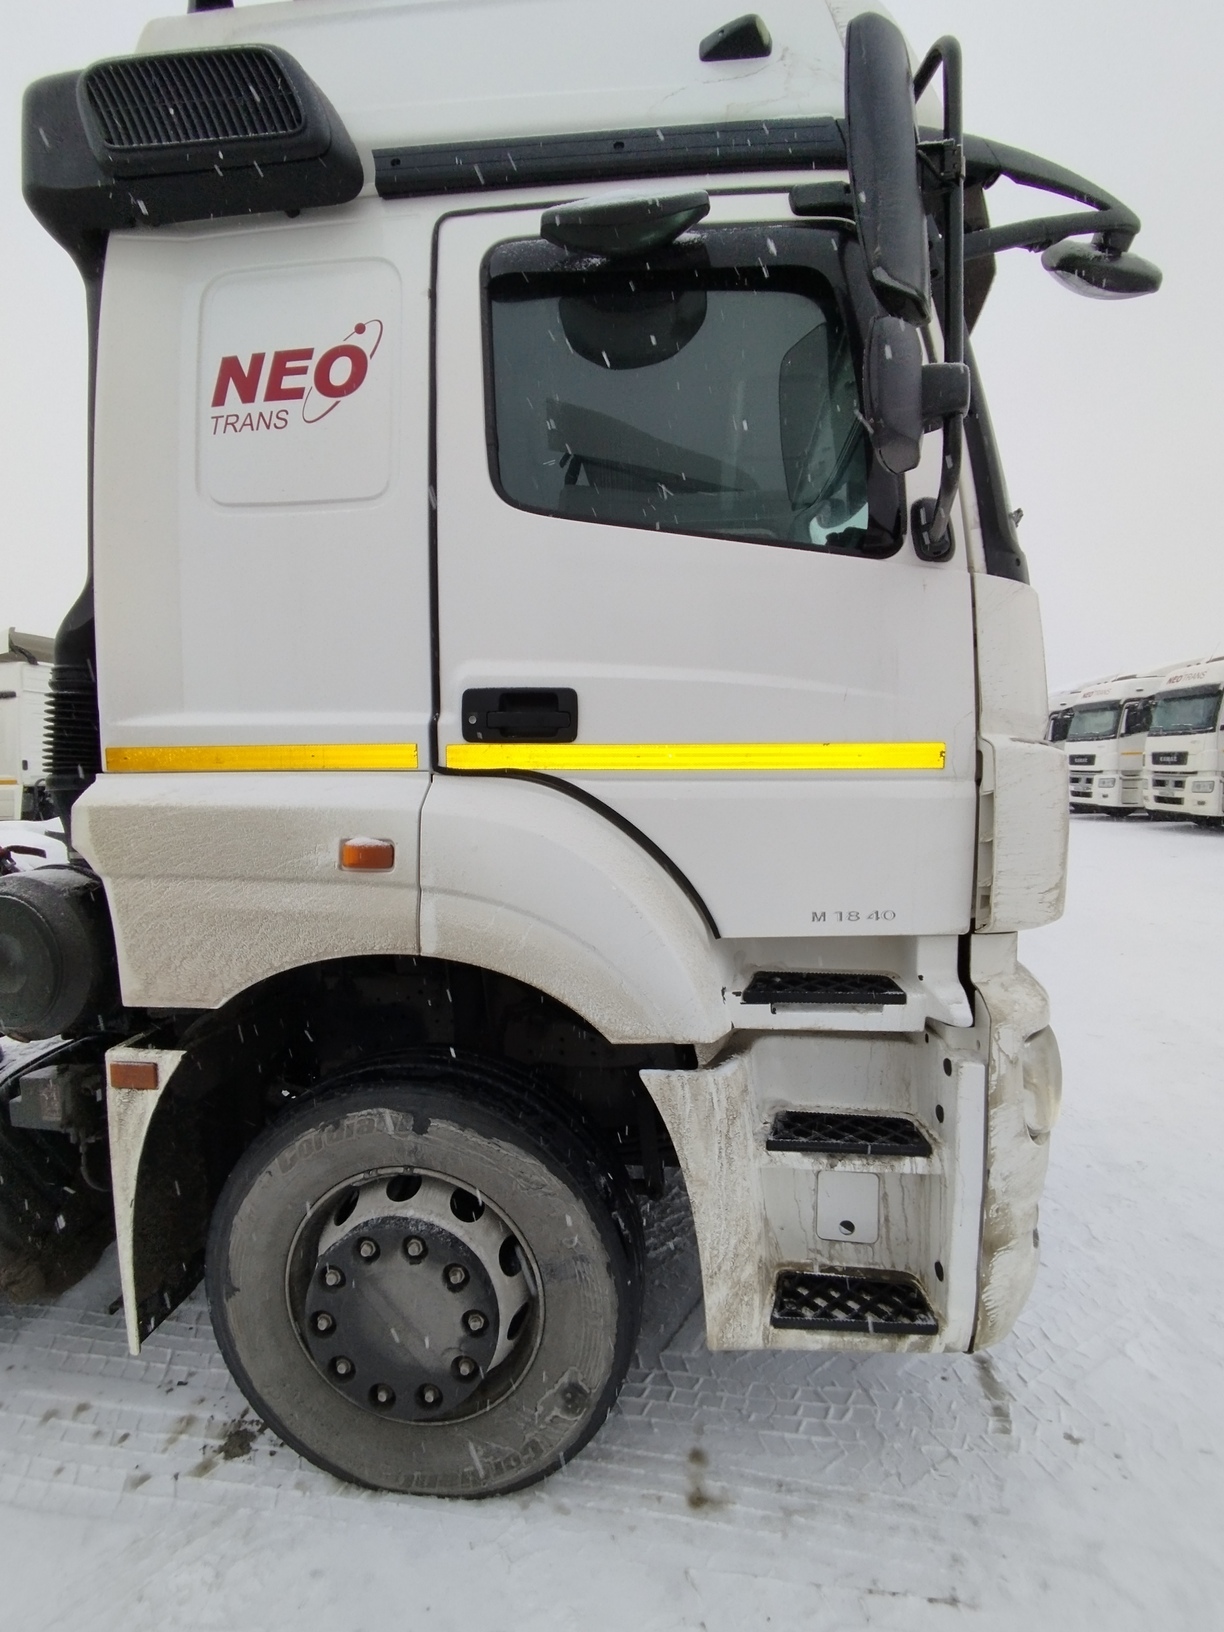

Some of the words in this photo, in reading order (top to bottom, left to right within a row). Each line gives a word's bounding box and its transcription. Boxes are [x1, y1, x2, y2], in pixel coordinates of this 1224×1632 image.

[211, 344, 368, 407] NEO
[211, 409, 289, 435] TRANS
[1166, 675, 1183, 685] NEO
